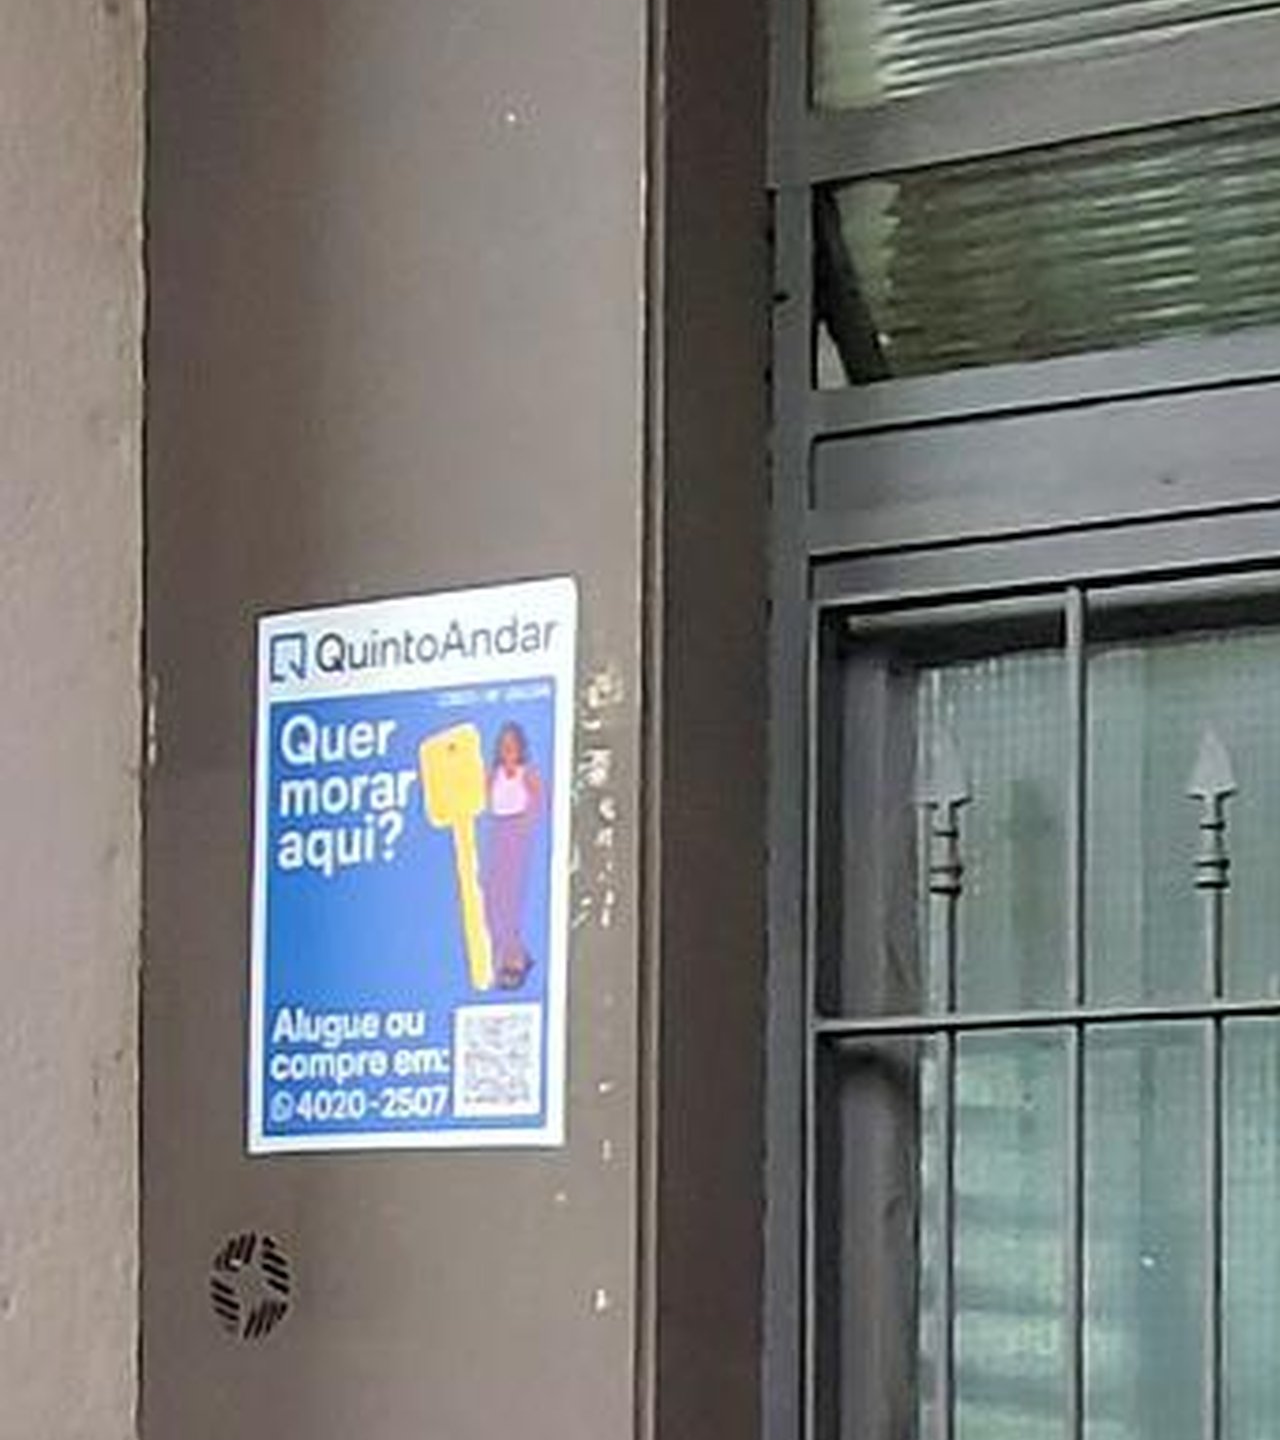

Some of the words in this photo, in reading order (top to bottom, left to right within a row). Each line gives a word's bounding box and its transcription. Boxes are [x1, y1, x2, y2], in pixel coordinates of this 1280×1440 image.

[315, 616, 557, 673] QuintoAndar
[281, 714, 396, 765] Quer
[279, 770, 416, 817] morar
[278, 810, 403, 878] aqui?
[272, 1007, 379, 1049] Alugue
[386, 1011, 425, 1038] ou
[270, 1049, 388, 1085] compre
[394, 1046, 450, 1077] em:
